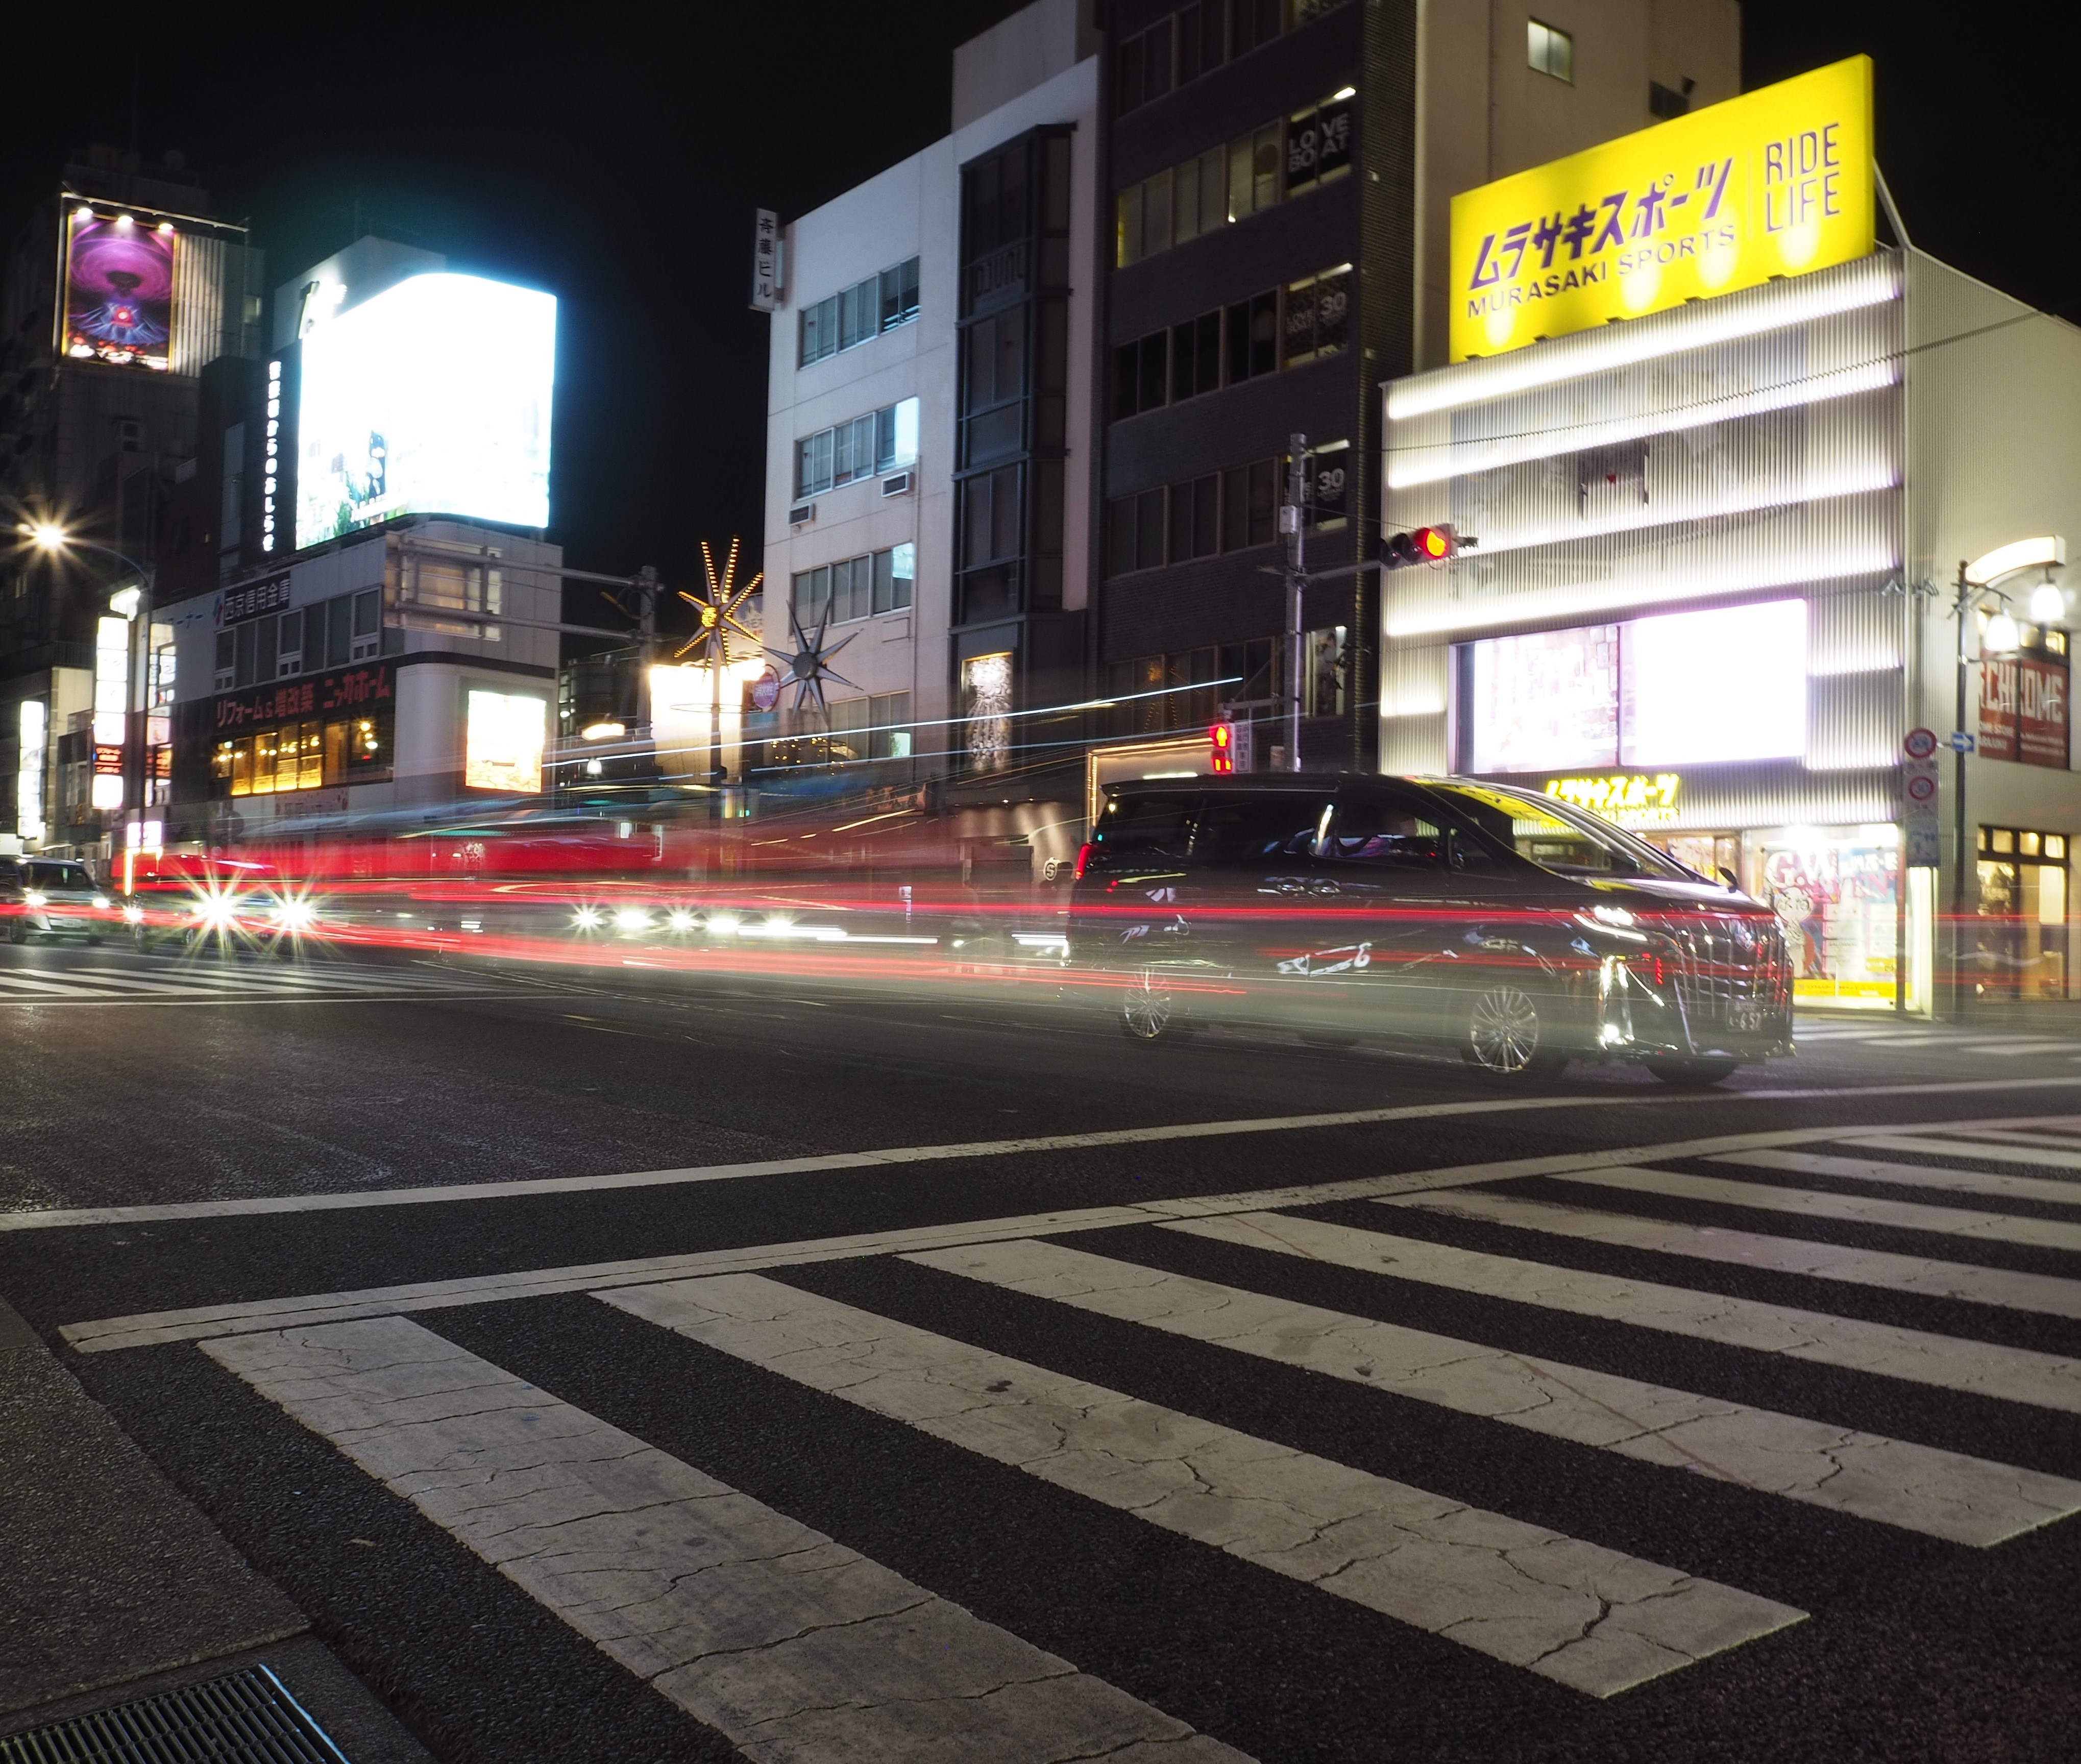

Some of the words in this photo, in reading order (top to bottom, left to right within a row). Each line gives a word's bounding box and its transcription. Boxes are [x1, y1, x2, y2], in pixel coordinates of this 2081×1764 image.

[1288, 112, 1349, 155] LOVE
[1288, 131, 1349, 173] BOAT
[1765, 122, 1840, 186] RIDE
[1468, 157, 1733, 291] ムラサキスポーツ
[1766, 172, 1840, 234] LIFE
[1467, 260, 1607, 319] MURASAKI
[1616, 223, 1736, 276] SPORTS
[1318, 468, 1344, 492] 30
[225, 578, 290, 621] 西京信用金庫
[323, 665, 391, 708] ニッカホーム
[1986, 660, 2064, 724] CHROME
